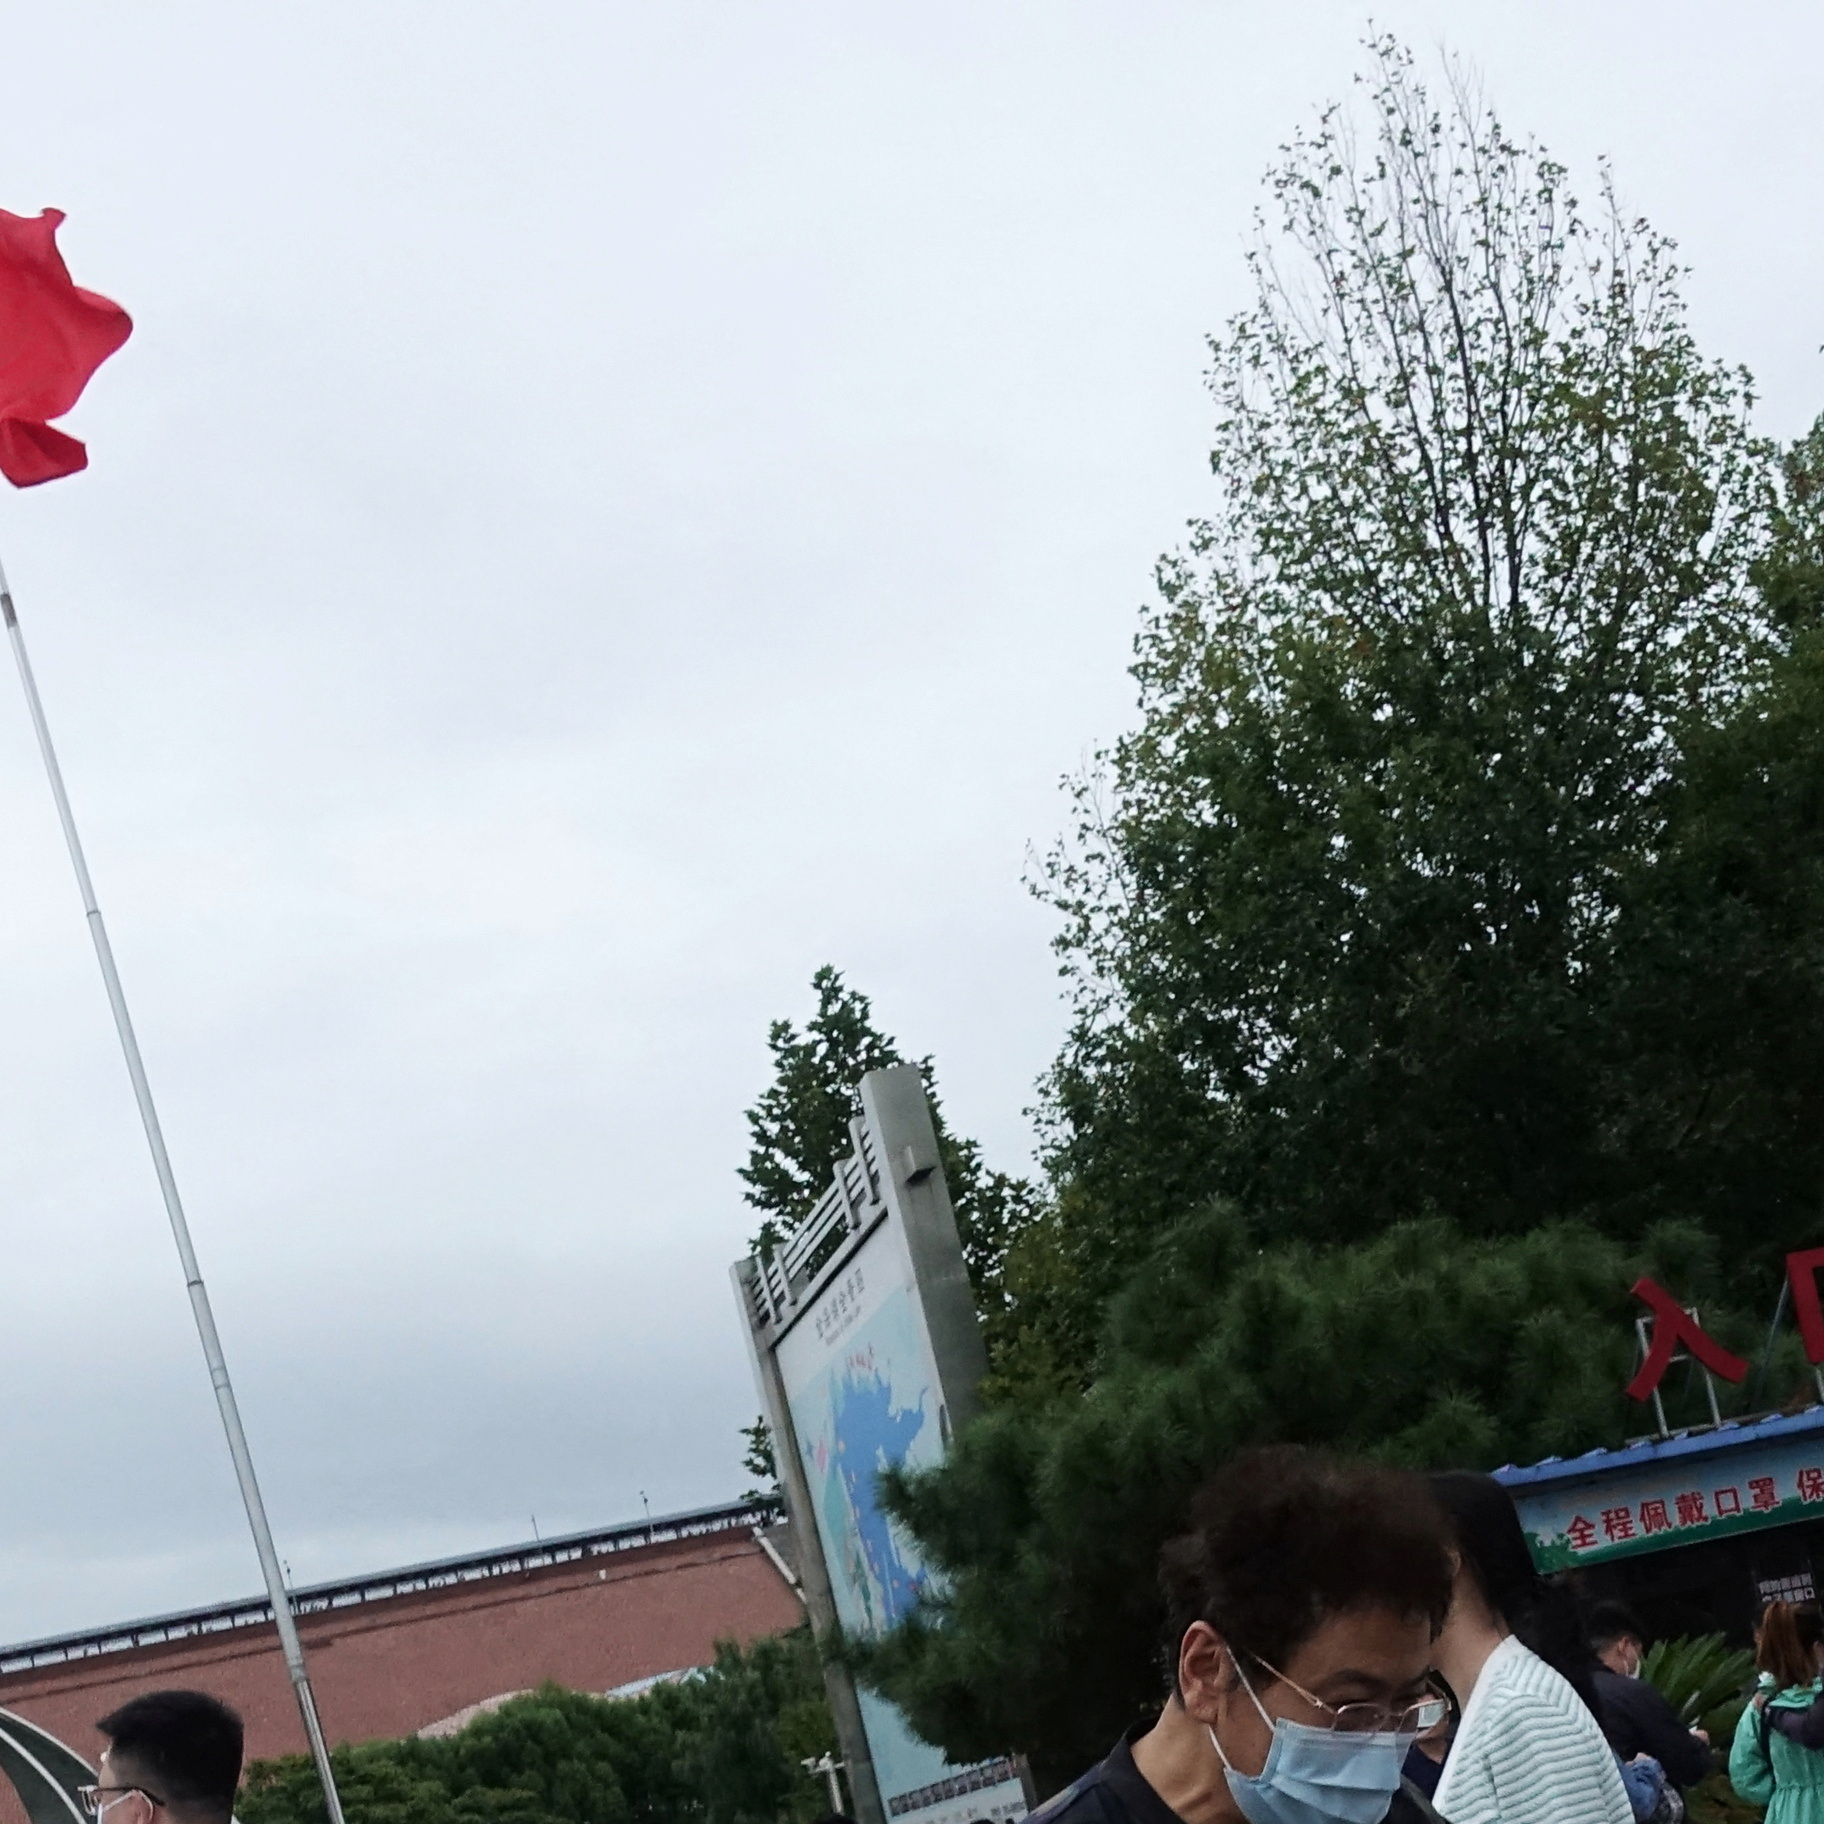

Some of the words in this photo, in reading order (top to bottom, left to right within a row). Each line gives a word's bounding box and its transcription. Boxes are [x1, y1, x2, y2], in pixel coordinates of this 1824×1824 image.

[1565, 1475, 1782, 1551] 全程佩戴口罩
